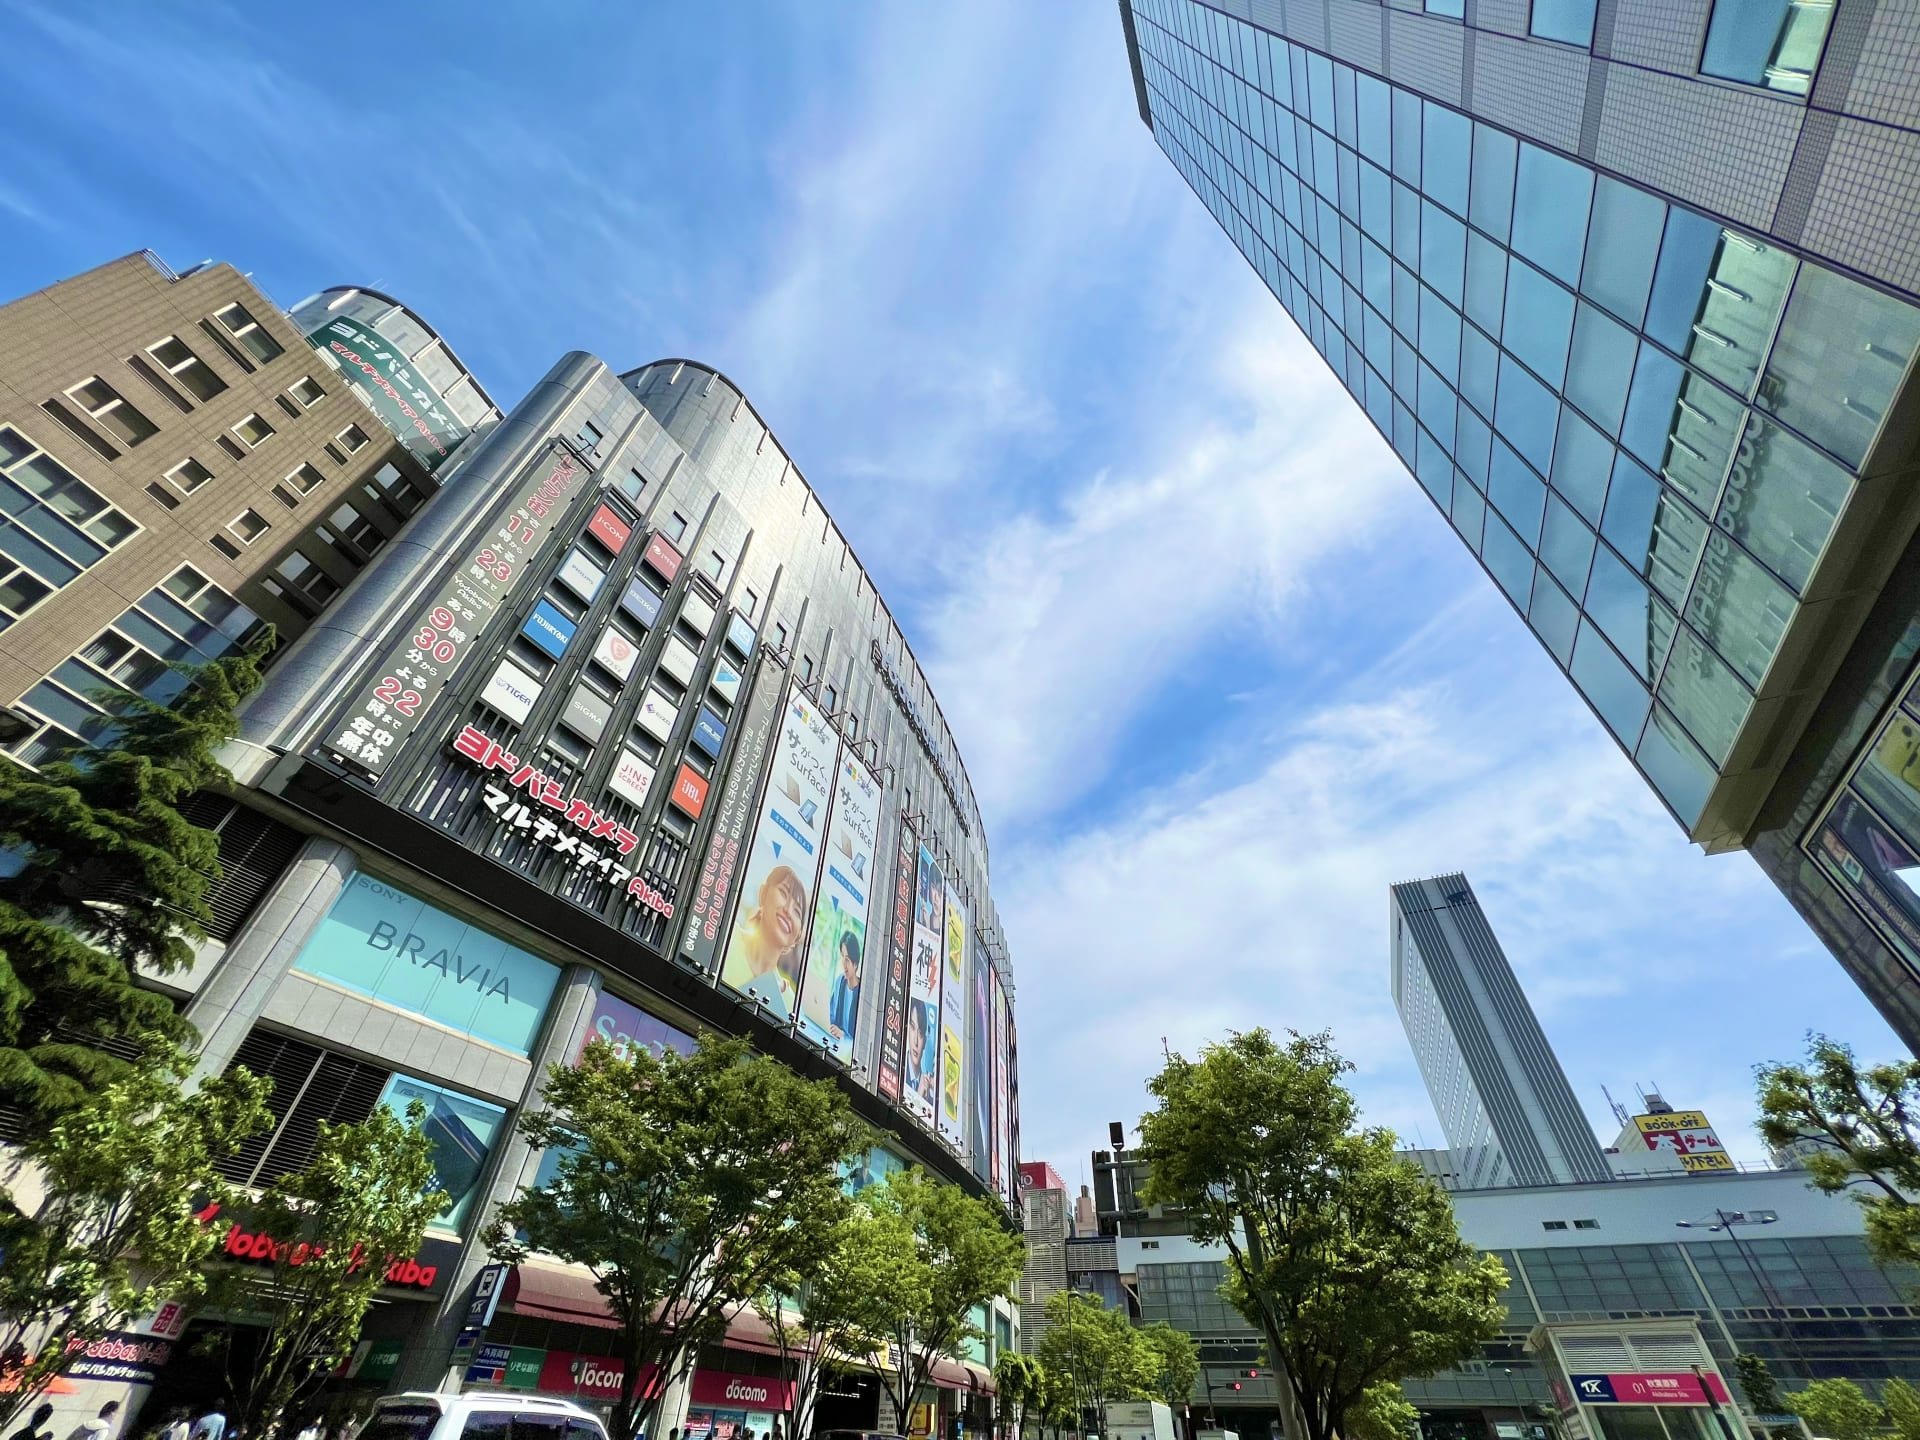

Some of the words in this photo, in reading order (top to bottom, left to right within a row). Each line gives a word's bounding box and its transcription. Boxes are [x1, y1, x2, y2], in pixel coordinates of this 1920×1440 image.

[329, 322, 464, 440] ヨドバシカメラ
[330, 340, 418, 419] マルチメディア
[413, 418, 448, 457] Akiba
[508, 515, 535, 544] 11
[517, 507, 542, 529] あさ
[490, 543, 516, 563] よる
[498, 528, 523, 554] 時から
[470, 564, 499, 591] 時まで
[476, 549, 512, 582] 23
[454, 576, 494, 610] Yodobashi
[457, 589, 483, 610] Akiba
[447, 597, 477, 621] あさ
[429, 606, 468, 644] 9時
[413, 626, 456, 664] 30
[405, 648, 439, 677] 分から
[601, 655, 625, 673] msi
[395, 666, 428, 690] よる
[373, 676, 422, 717] 22
[504, 683, 532, 707] TIGER
[365, 698, 403, 730] 時まで
[573, 700, 603, 726] SIGMA
[350, 715, 395, 748] 年中
[699, 720, 723, 744] ASUS
[336, 730, 384, 764] 無休
[618, 771, 646, 796] SCREEN
[790, 752, 826, 798] Surface
[453, 725, 640, 855] ヨドバシカメラ
[681, 778, 700, 804] JBL
[843, 809, 873, 850] Surface
[483, 783, 632, 886] マルチメディア
[628, 876, 675, 919] Akiba
[358, 877, 409, 905] SONY
[366, 919, 511, 1005] BRAVIA
[886, 1005, 901, 1036] 24
[1684, 1133, 1721, 1149] ゲーム
[510, 1361, 540, 1374] りそな銀行
[726, 1379, 767, 1403] docomo
[1580, 1379, 1602, 1394] TX
[1632, 1382, 1647, 1395] 01
